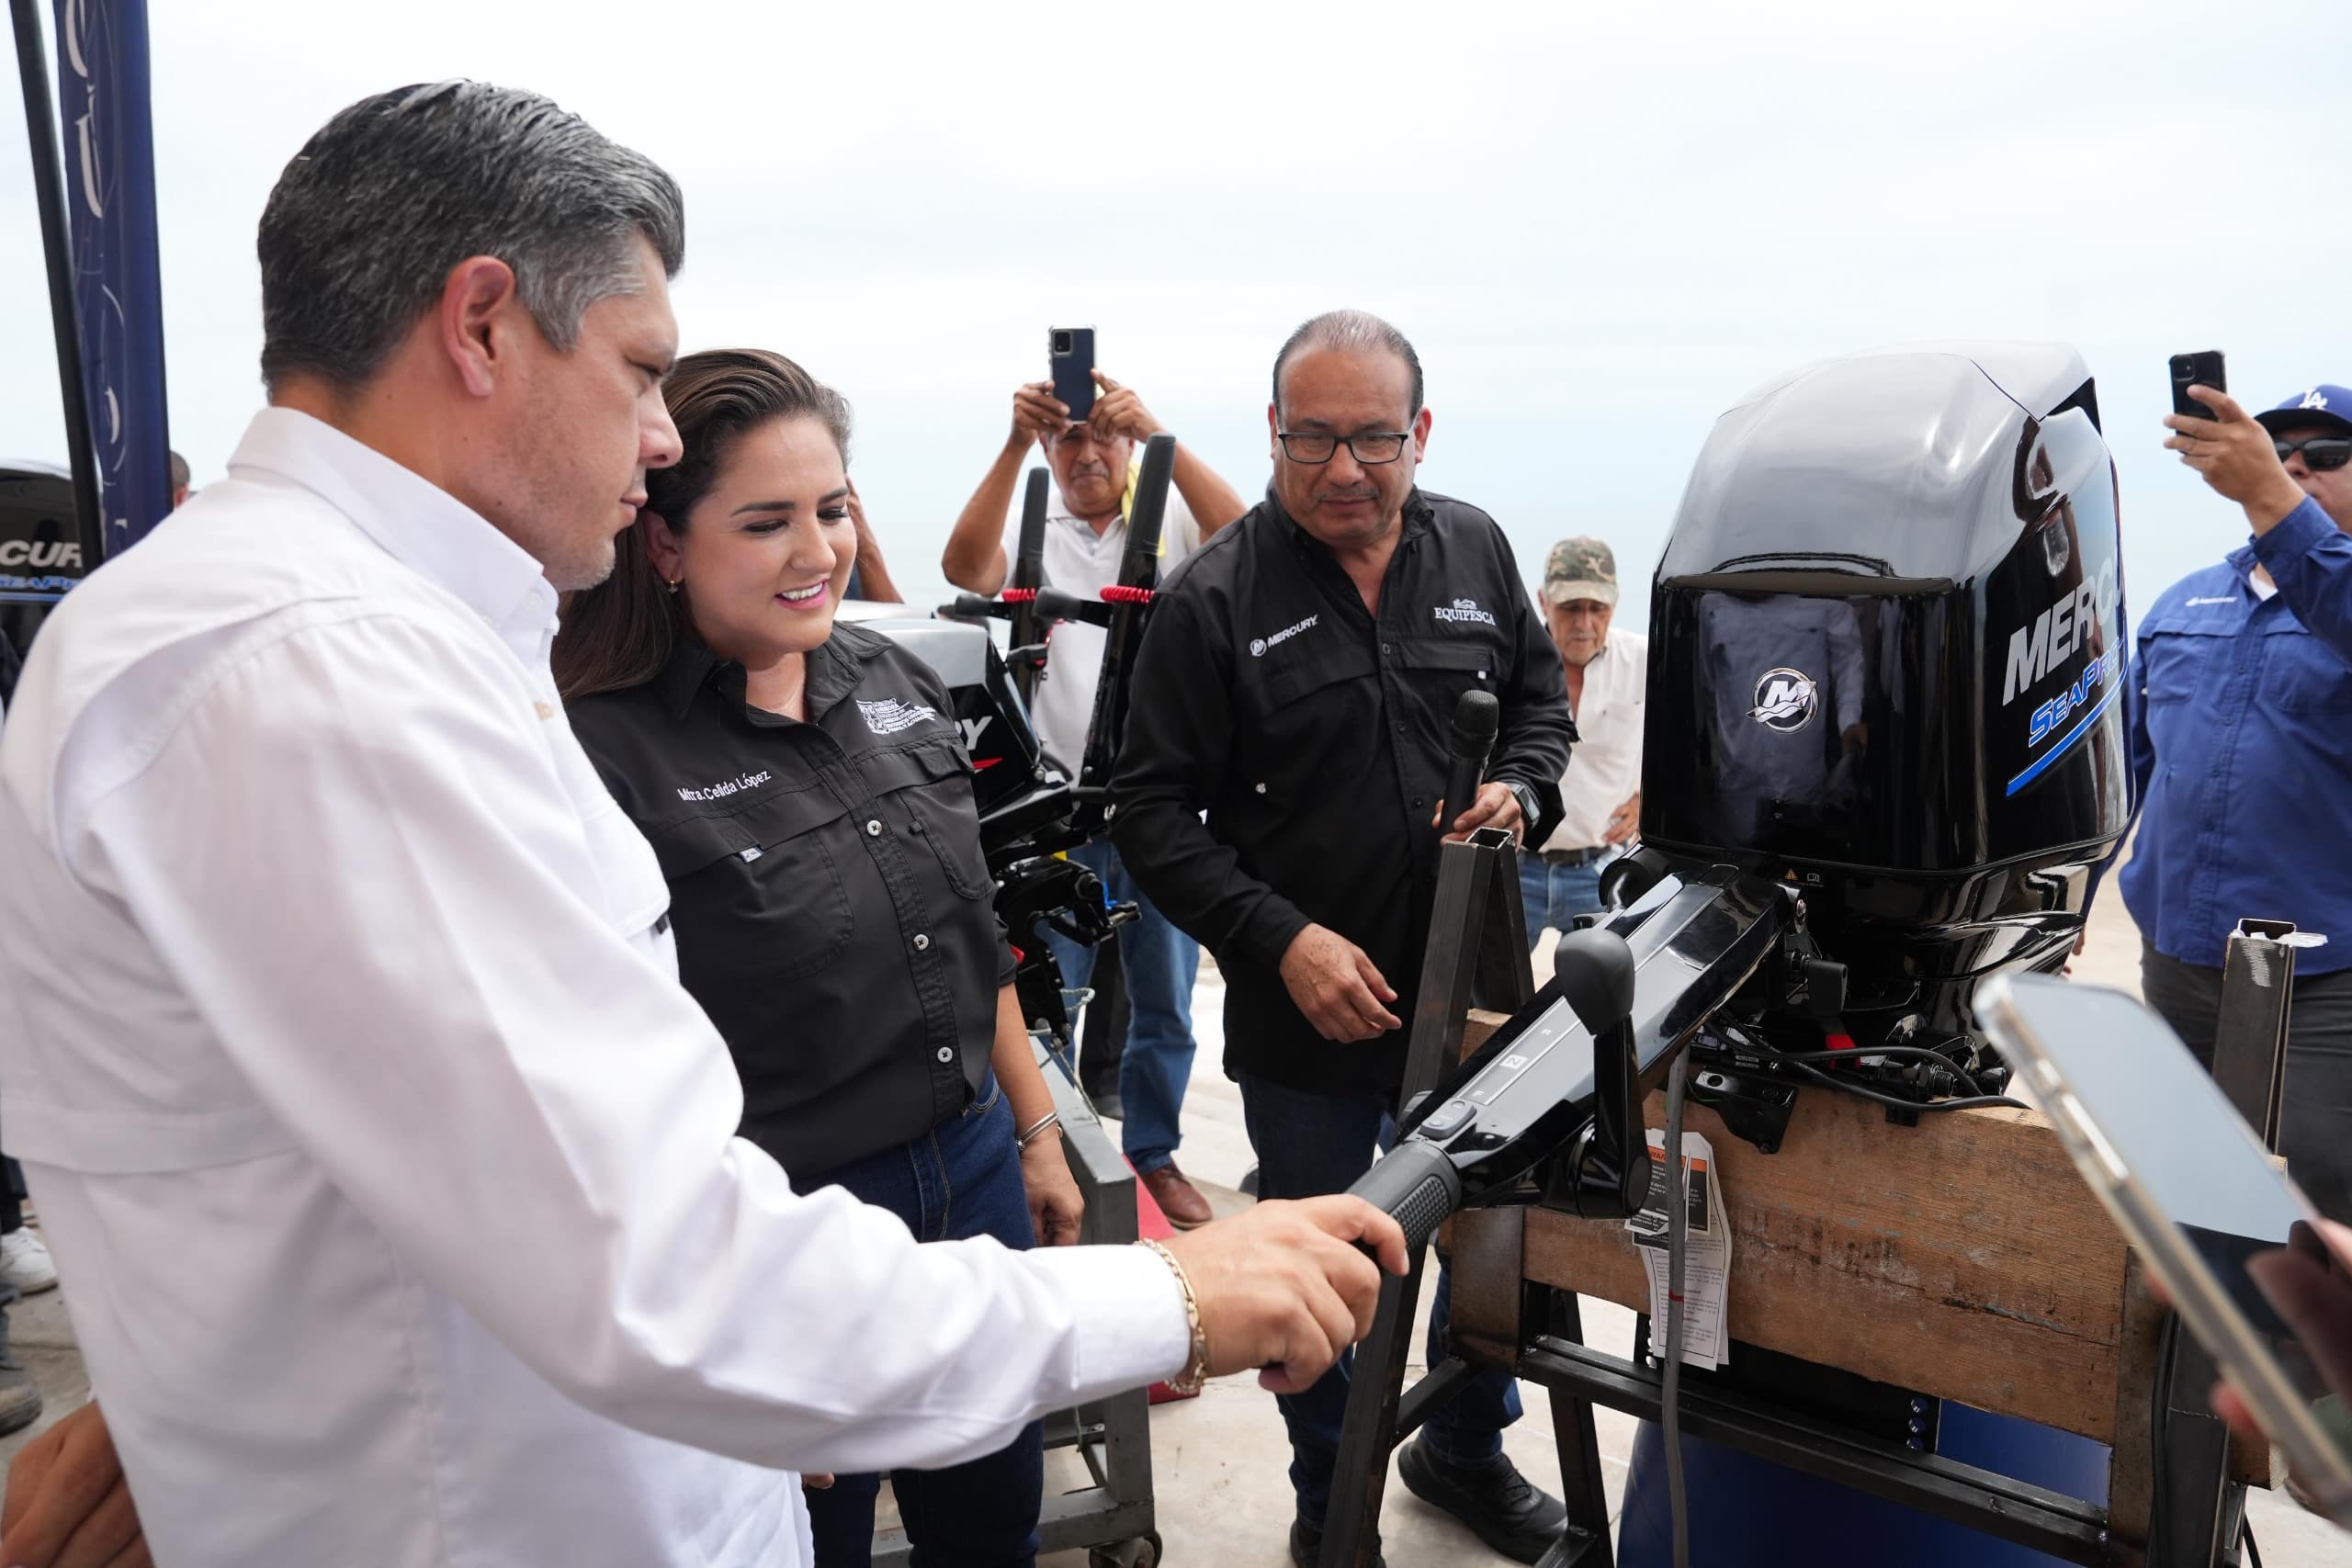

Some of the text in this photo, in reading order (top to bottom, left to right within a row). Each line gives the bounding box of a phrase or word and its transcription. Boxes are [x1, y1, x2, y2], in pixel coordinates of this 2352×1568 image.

[1433, 607, 1497, 626] EQUIPESCA
[1267, 615, 1317, 648] MERCURY
[735, 771, 772, 790] López
